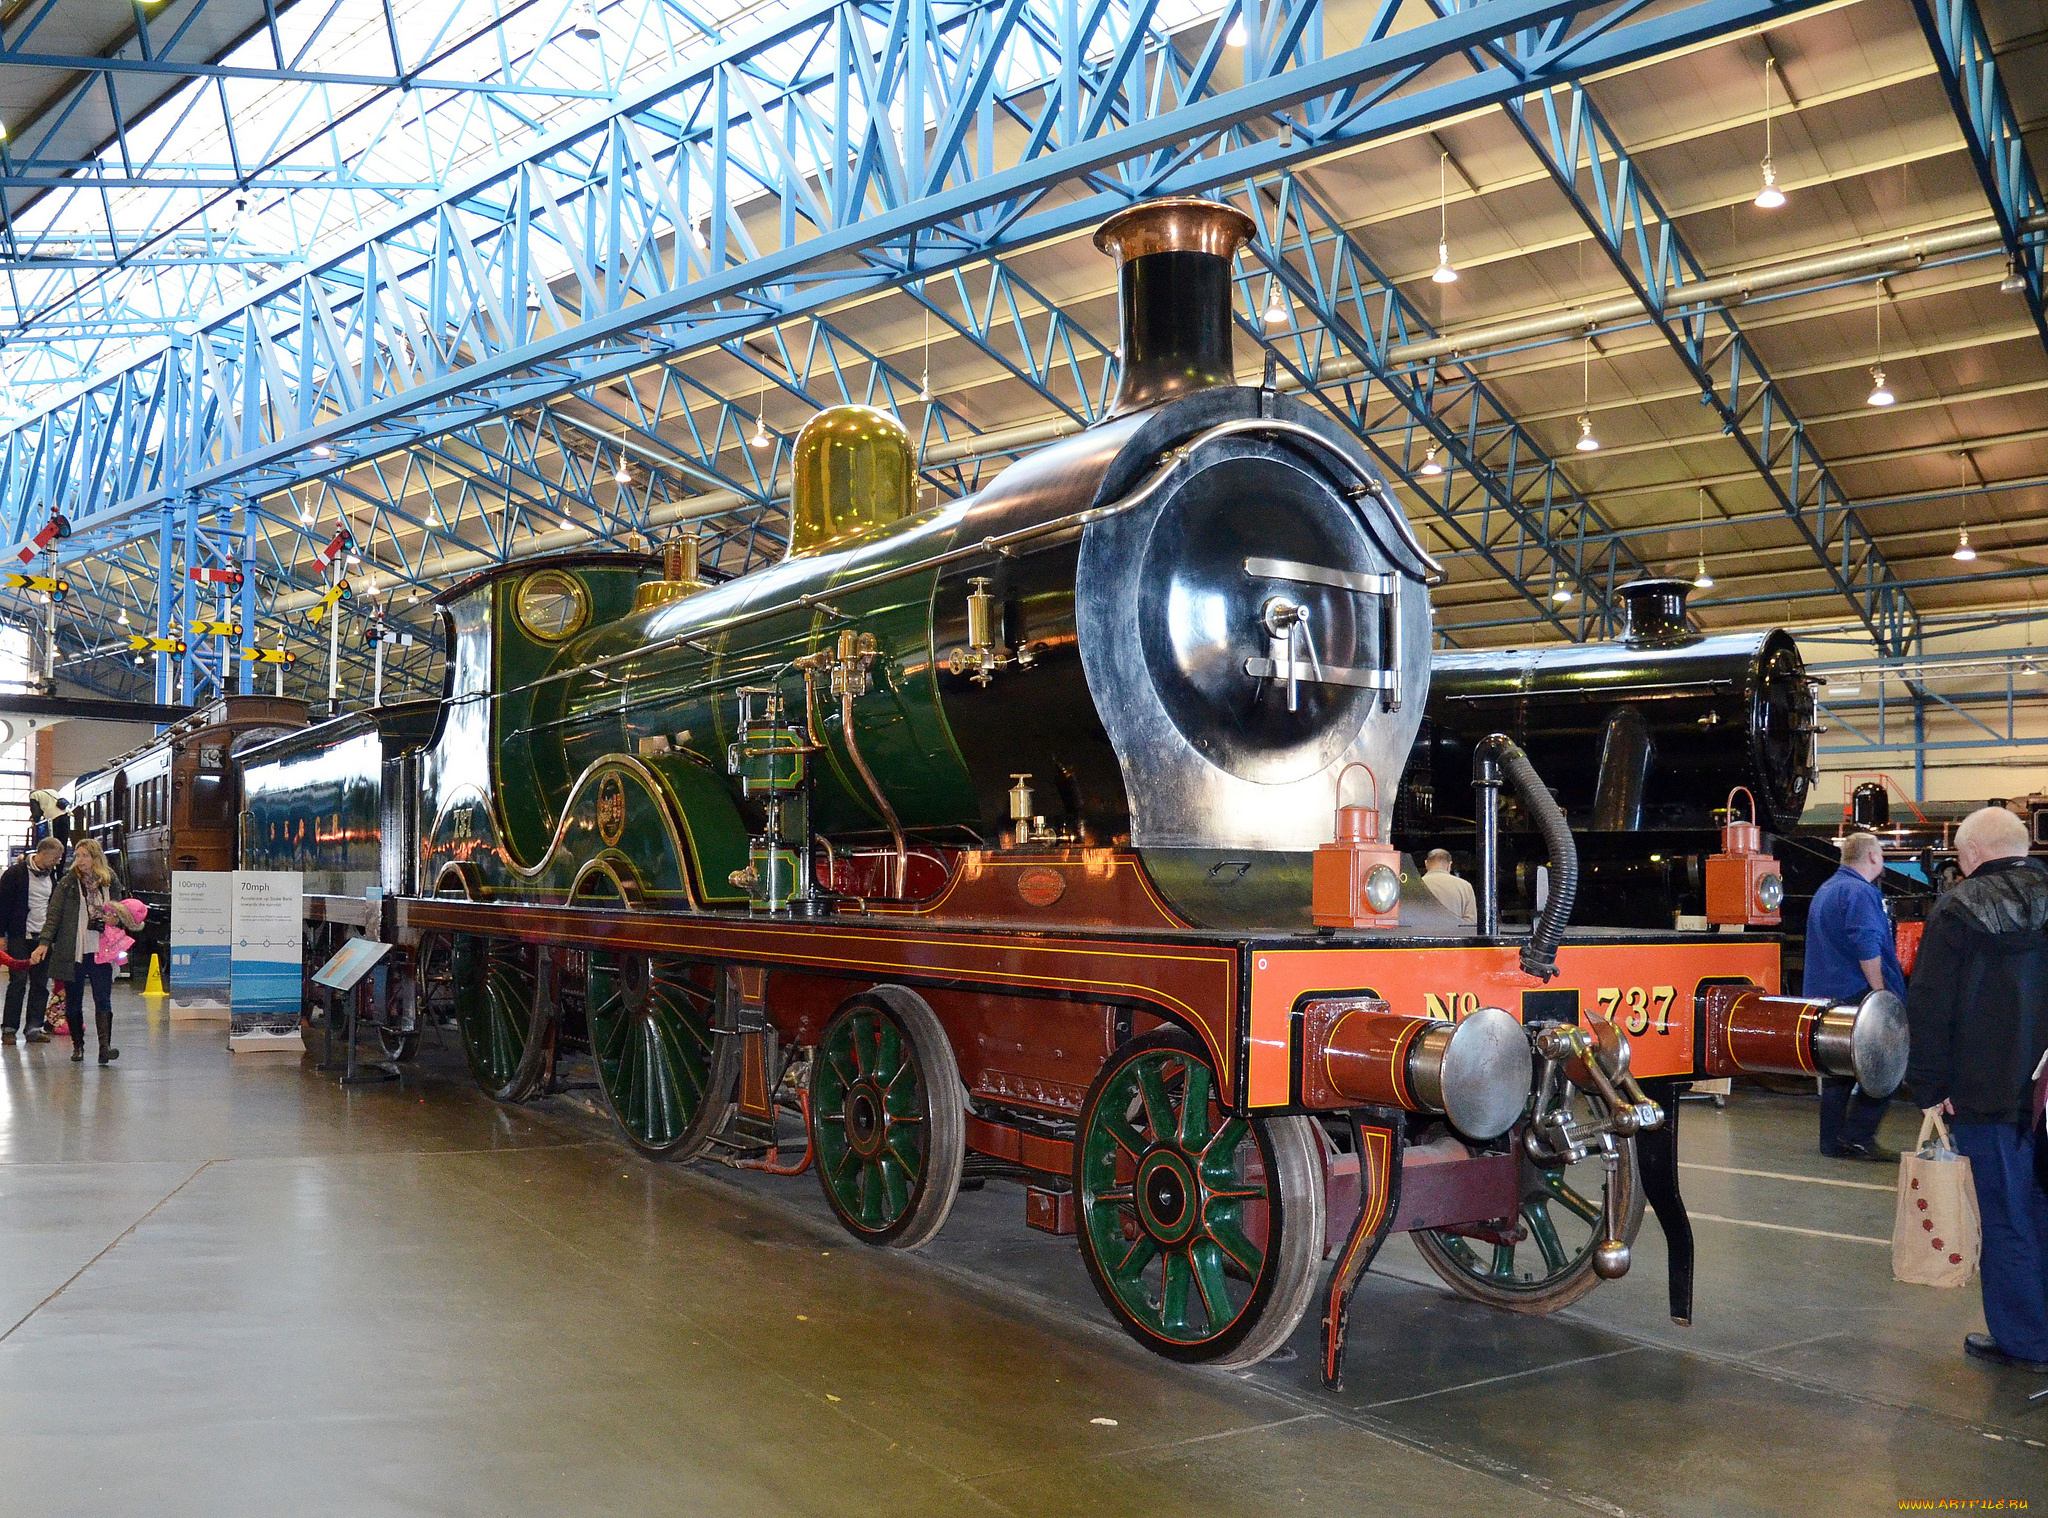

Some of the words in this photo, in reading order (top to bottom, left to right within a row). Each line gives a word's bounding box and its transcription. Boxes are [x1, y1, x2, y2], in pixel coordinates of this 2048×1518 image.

[178, 880, 207, 889] 100mph
[240, 882, 270, 893] 70mph
[1597, 986, 1677, 1035] 737
